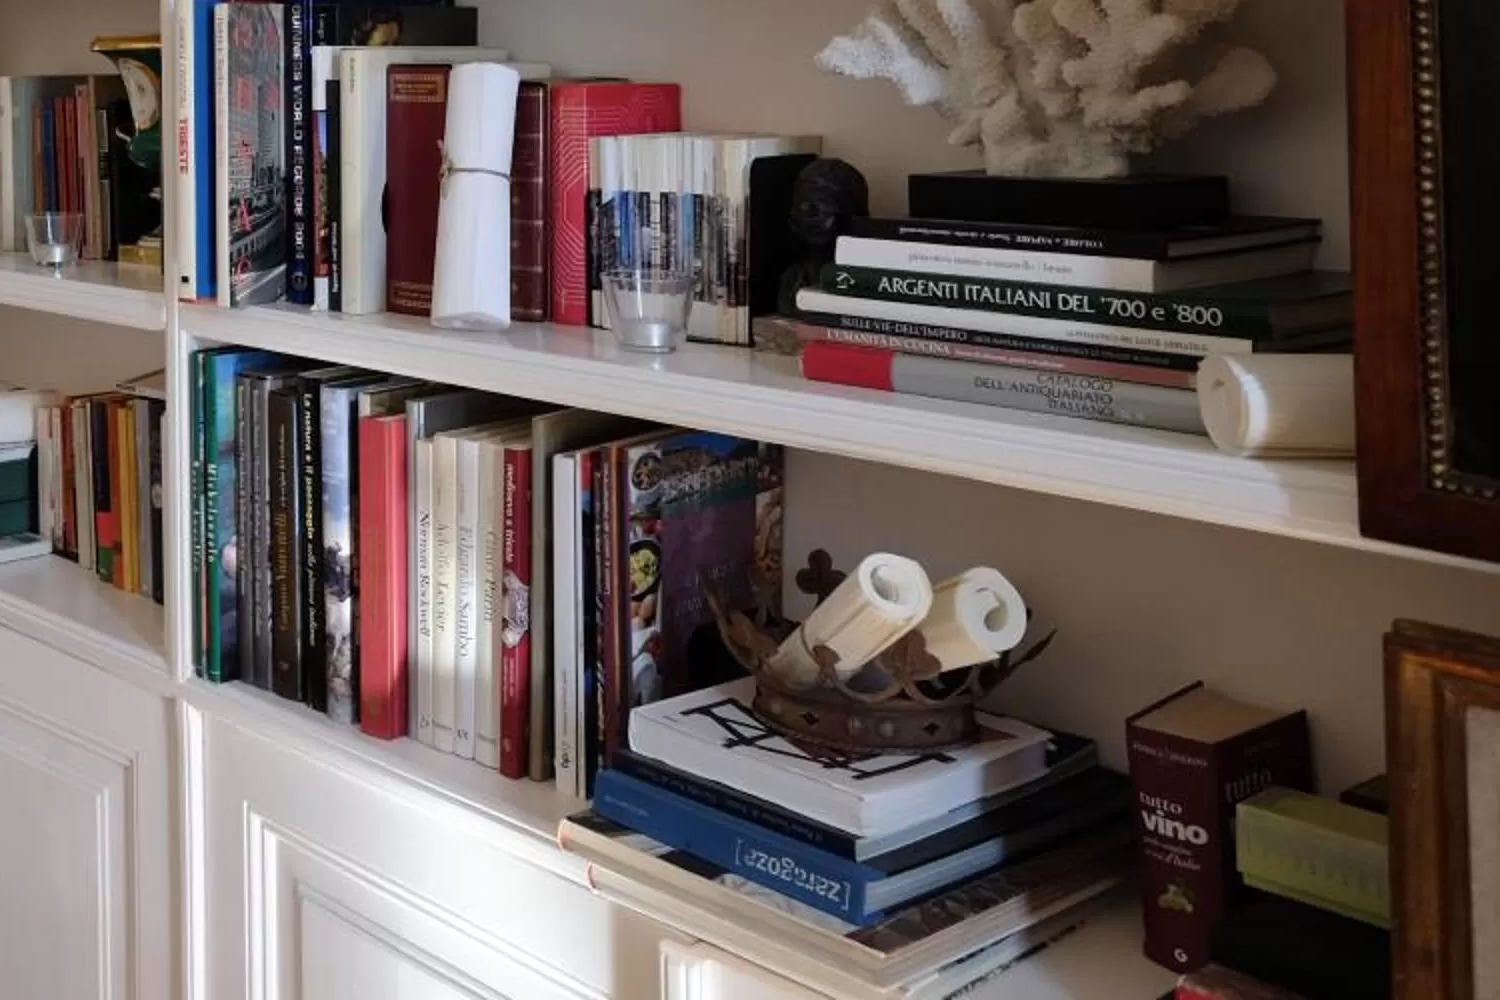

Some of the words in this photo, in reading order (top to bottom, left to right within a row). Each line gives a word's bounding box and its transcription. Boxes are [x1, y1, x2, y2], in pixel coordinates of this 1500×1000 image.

[292, 85, 304, 141] WORLD
[178, 118, 189, 175] TRIESTE
[293, 145, 304, 216] RECORDS
[878, 276, 958, 300] ARGENTI
[964, 285, 1051, 309] ITALIANI
[1058, 293, 1095, 313] DEL
[1101, 297, 1146, 319] '700
[1151, 307, 1166, 321] e
[1173, 303, 1223, 327] '800
[303, 393, 313, 409] La
[1036, 373, 1113, 392] CATALOGO
[303, 411, 313, 451] natura
[209, 464, 218, 563] Michelangelo
[303, 476, 316, 539] paesaggio
[418, 511, 430, 570] Norman
[418, 575, 430, 637] Rockwell
[435, 582, 448, 632] Levier
[457, 600, 473, 658] Sambo
[1139, 791, 1183, 815] tutto
[1141, 809, 1209, 846] vino
